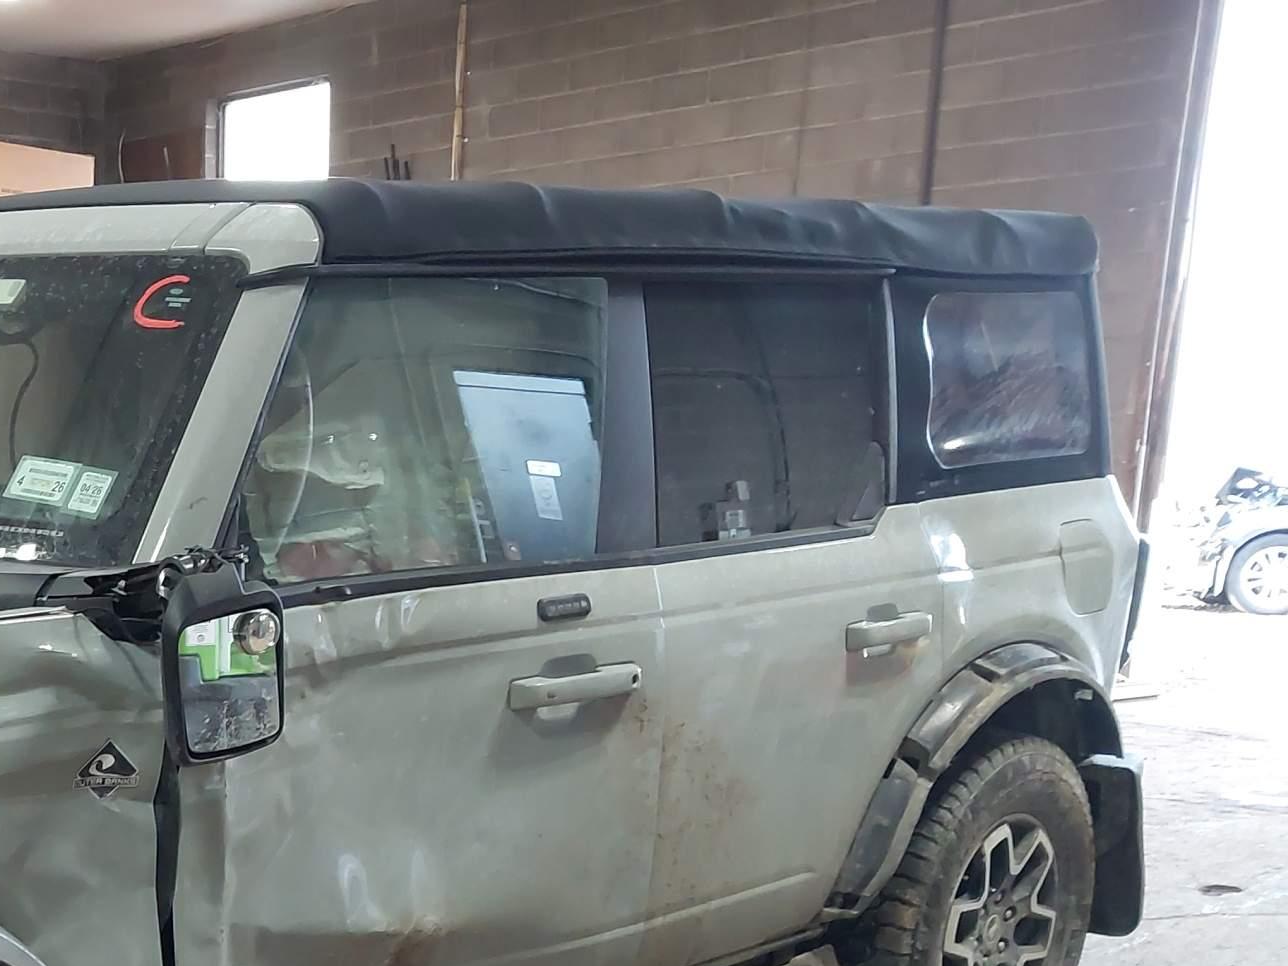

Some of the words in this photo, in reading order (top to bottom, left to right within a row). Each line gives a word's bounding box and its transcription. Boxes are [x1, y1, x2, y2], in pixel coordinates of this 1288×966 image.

[133, 274, 191, 329] C
[16, 475, 26, 487] 4
[51, 480, 66, 493] 26
